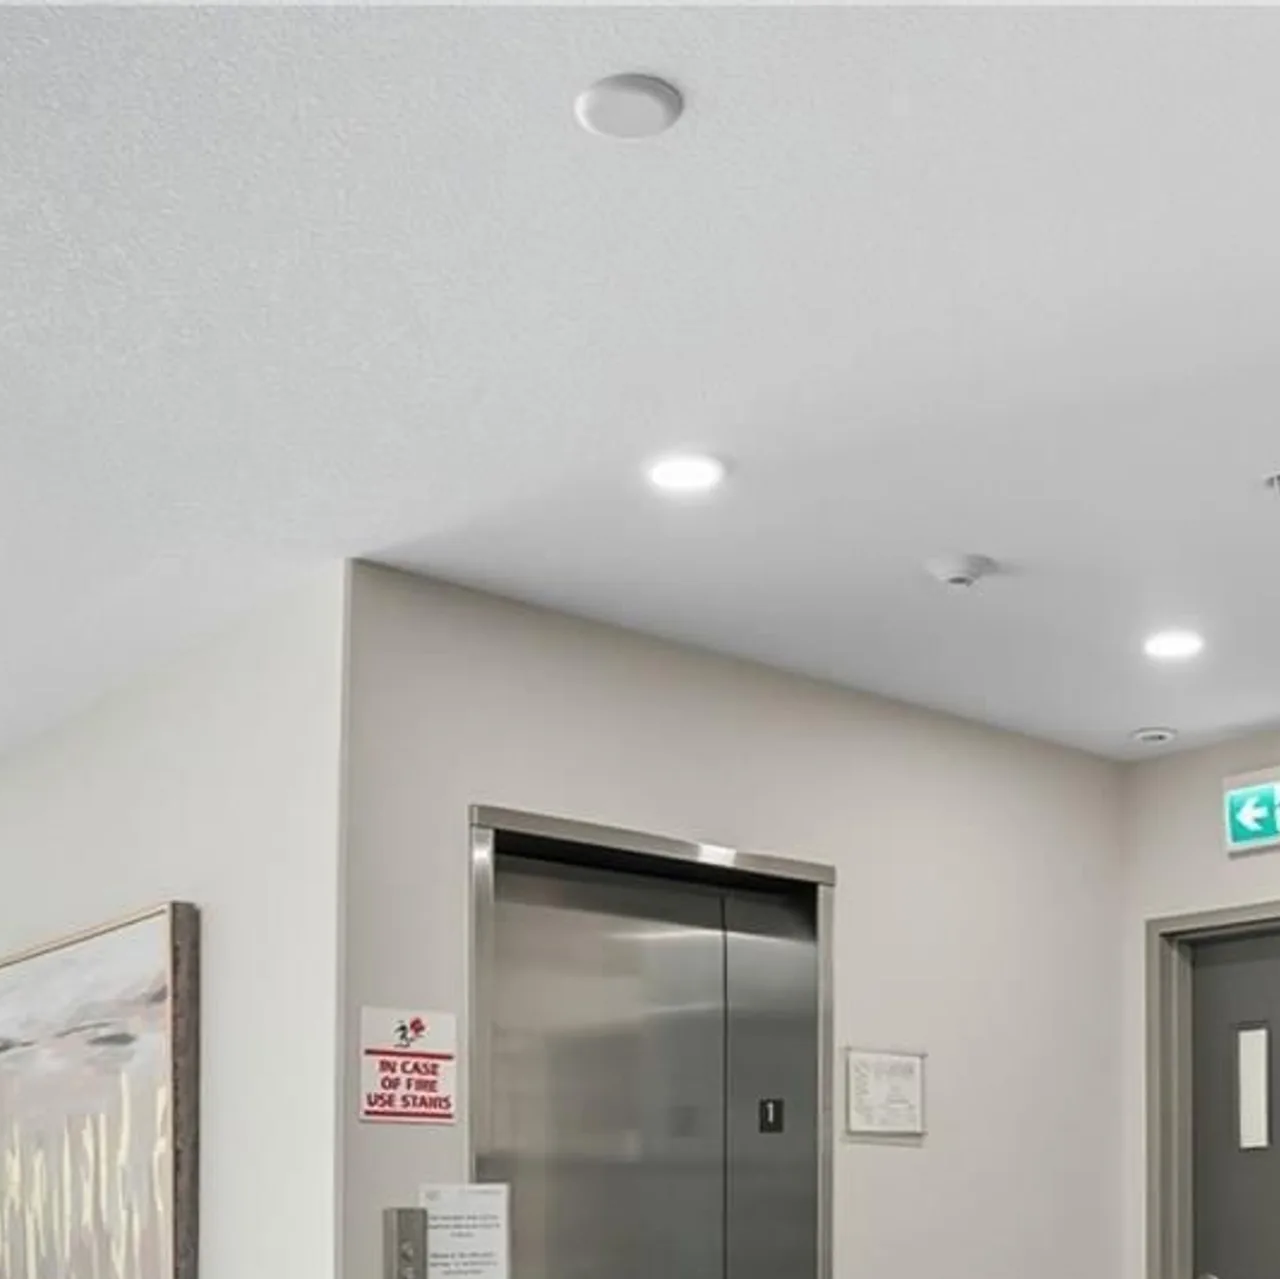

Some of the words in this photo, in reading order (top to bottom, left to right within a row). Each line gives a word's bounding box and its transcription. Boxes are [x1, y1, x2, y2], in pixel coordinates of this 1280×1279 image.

[380, 1060, 396, 1073] IN
[401, 1061, 439, 1076] CASE
[381, 1077, 400, 1090] OF
[407, 1078, 437, 1092] FIRE
[366, 1092, 395, 1108] USE
[401, 1094, 451, 1110] STAIRS
